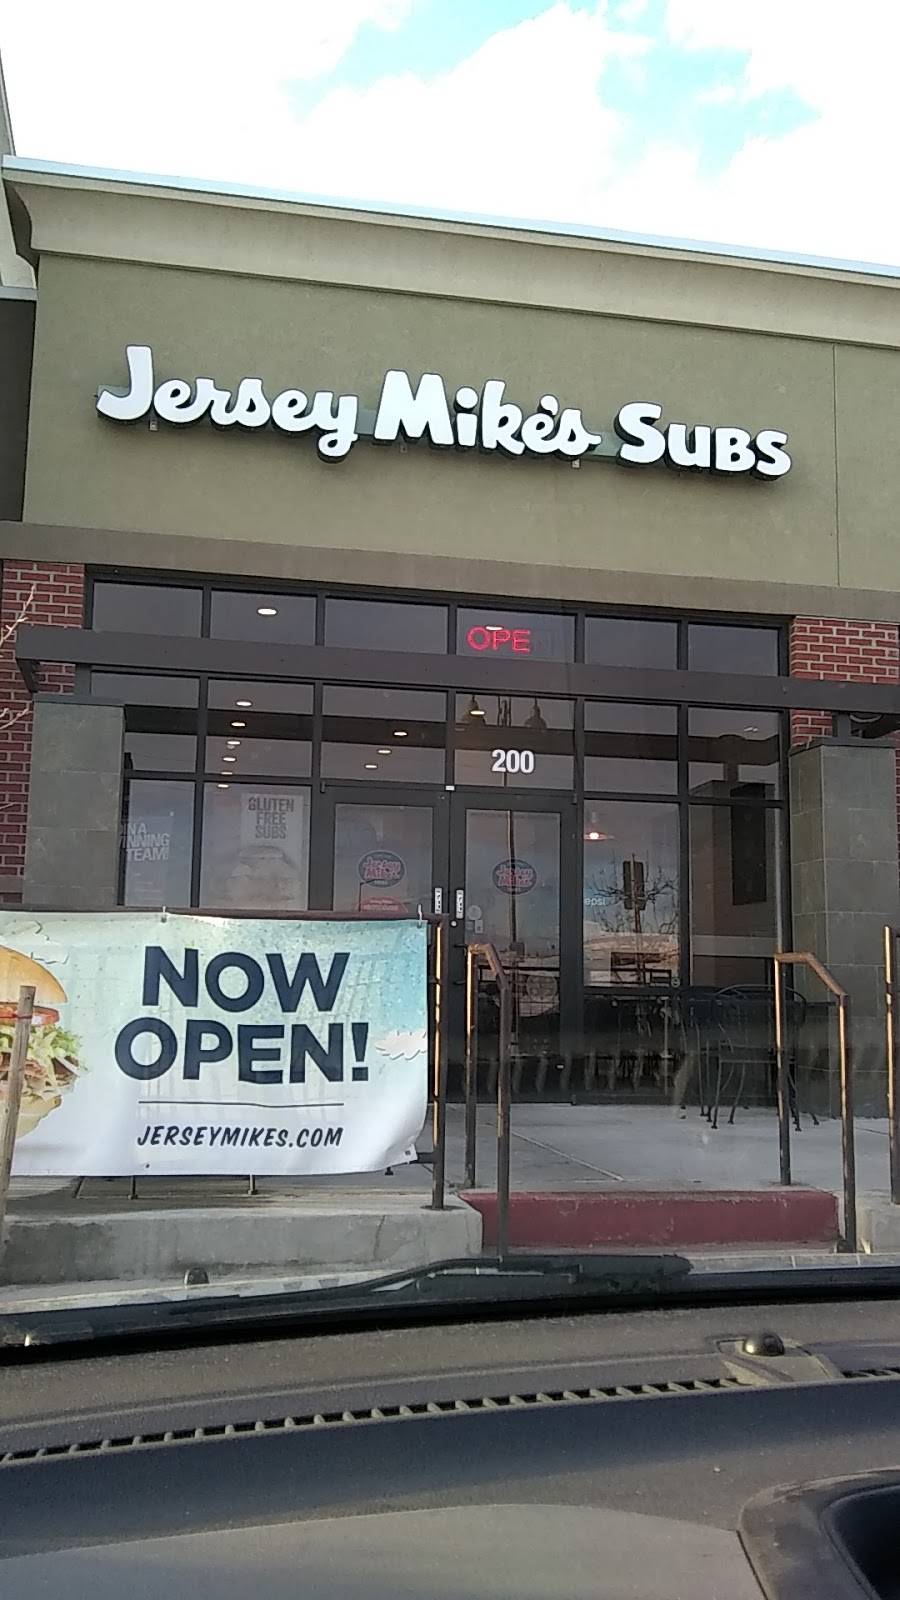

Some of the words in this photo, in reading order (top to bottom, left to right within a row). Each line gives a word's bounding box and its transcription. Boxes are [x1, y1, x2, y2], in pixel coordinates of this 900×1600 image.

[96, 345, 358, 458] Jersey
[373, 370, 603, 456] Mike's
[491, 748, 535, 774] 200
[248, 796, 295, 812] GLUTEN
[256, 811, 288, 825] FREE
[255, 824, 288, 840] SUBS
[583, 896, 607, 908] epsi
[142, 945, 350, 1013] NOW
[114, 1016, 369, 1084] OPEN!
[137, 1124, 344, 1148] JERSEYMIKES.COM
